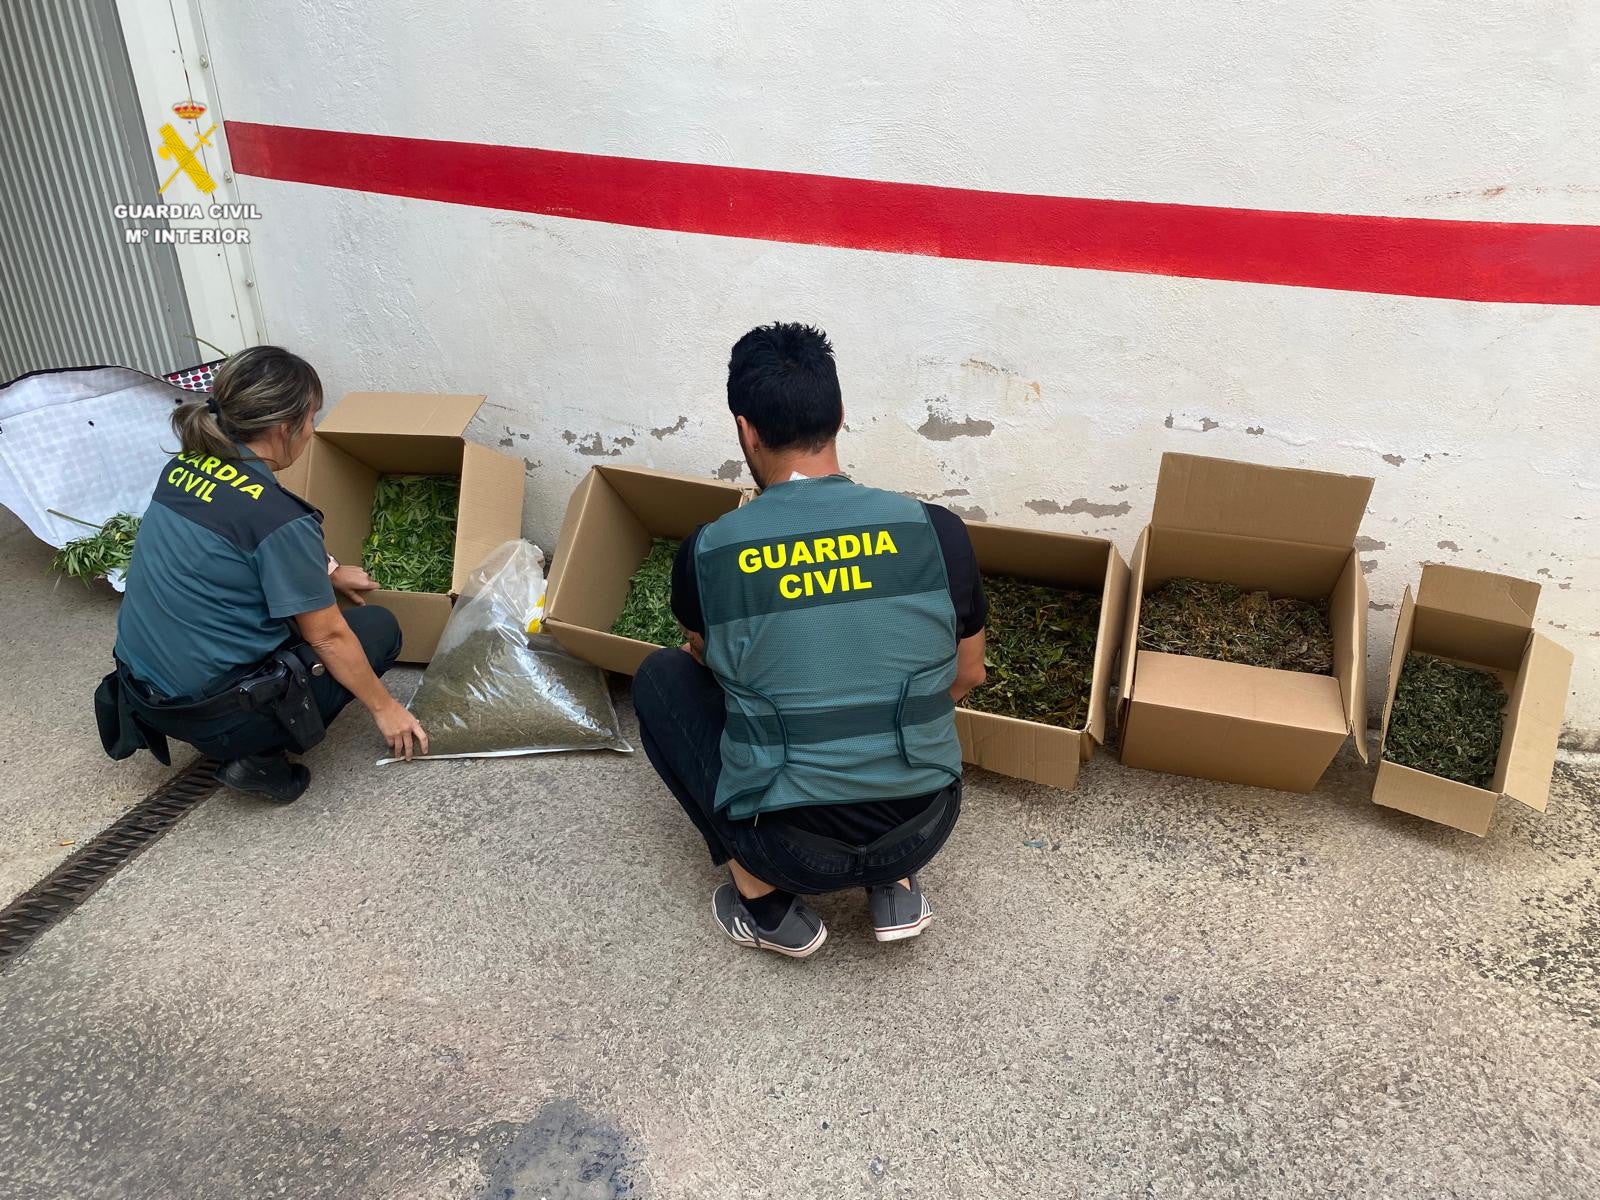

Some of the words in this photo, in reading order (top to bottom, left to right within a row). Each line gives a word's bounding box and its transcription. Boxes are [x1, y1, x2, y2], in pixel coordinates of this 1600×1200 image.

[168, 466, 217, 503] CIVIL
[177, 451, 264, 500] ARDIA
[738, 530, 898, 574] GUARDIA
[779, 565, 873, 599] CIVIL
